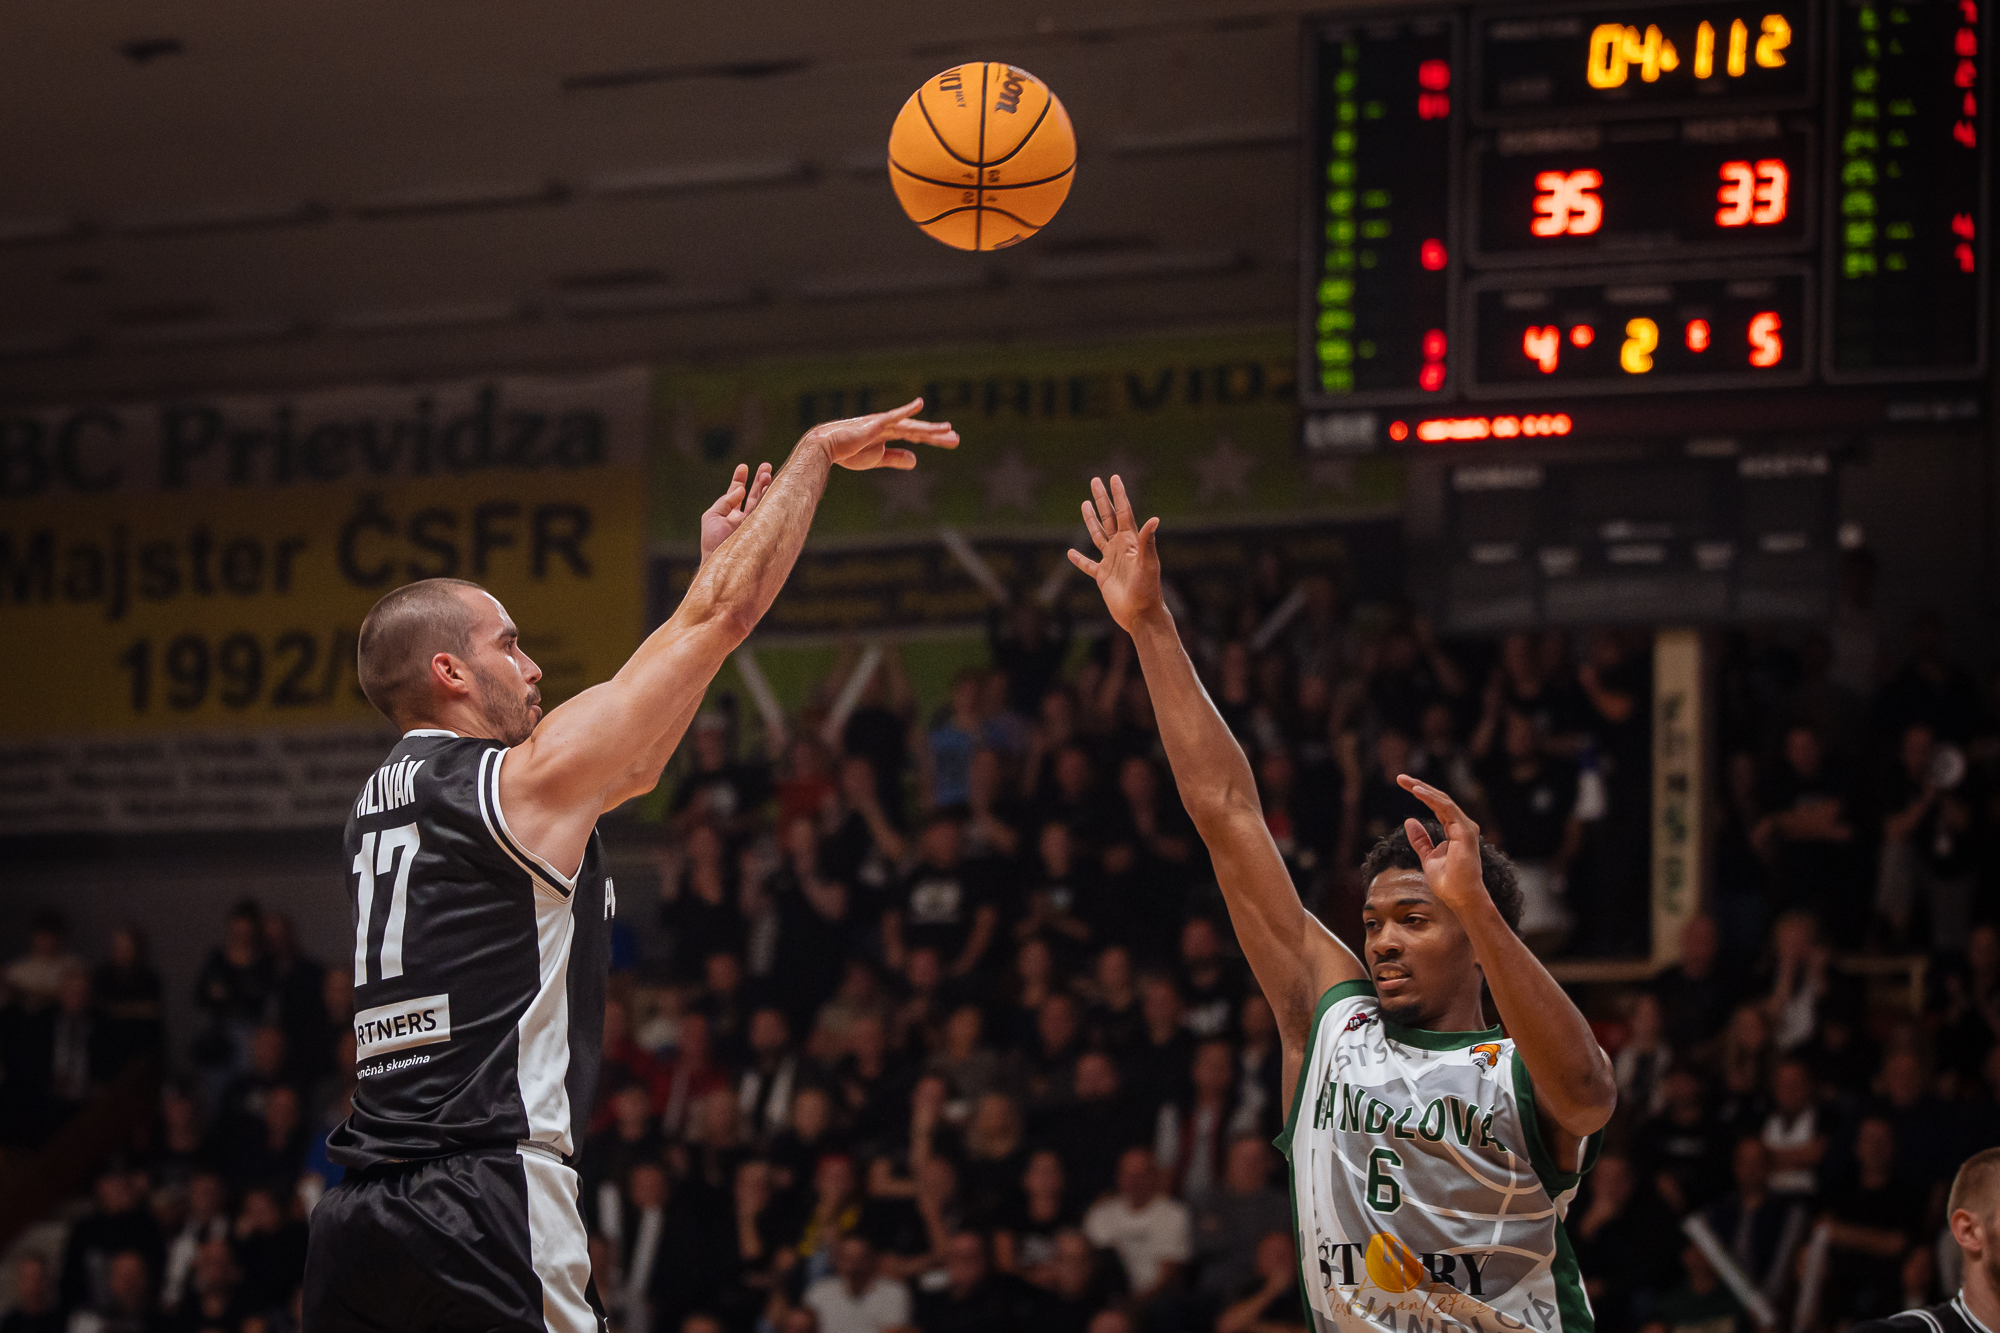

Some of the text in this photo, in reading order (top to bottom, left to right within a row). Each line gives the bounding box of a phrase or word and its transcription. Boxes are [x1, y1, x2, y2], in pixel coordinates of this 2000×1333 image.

[1531, 168, 1603, 237] 35
[1715, 158, 1790, 227] 33
[1523, 324, 1560, 374] 4
[1620, 317, 1659, 374] 2
[1748, 311, 1783, 368] 5
[158, 383, 612, 492] Prievidza
[0, 522, 308, 621] Majster
[337, 494, 594, 592] ČSFR
[352, 821, 420, 988] 17
[357, 1009, 437, 1048] RTNERS
[356, 1054, 431, 1080] nčná skupina
[1363, 1146, 1404, 1215] 6
